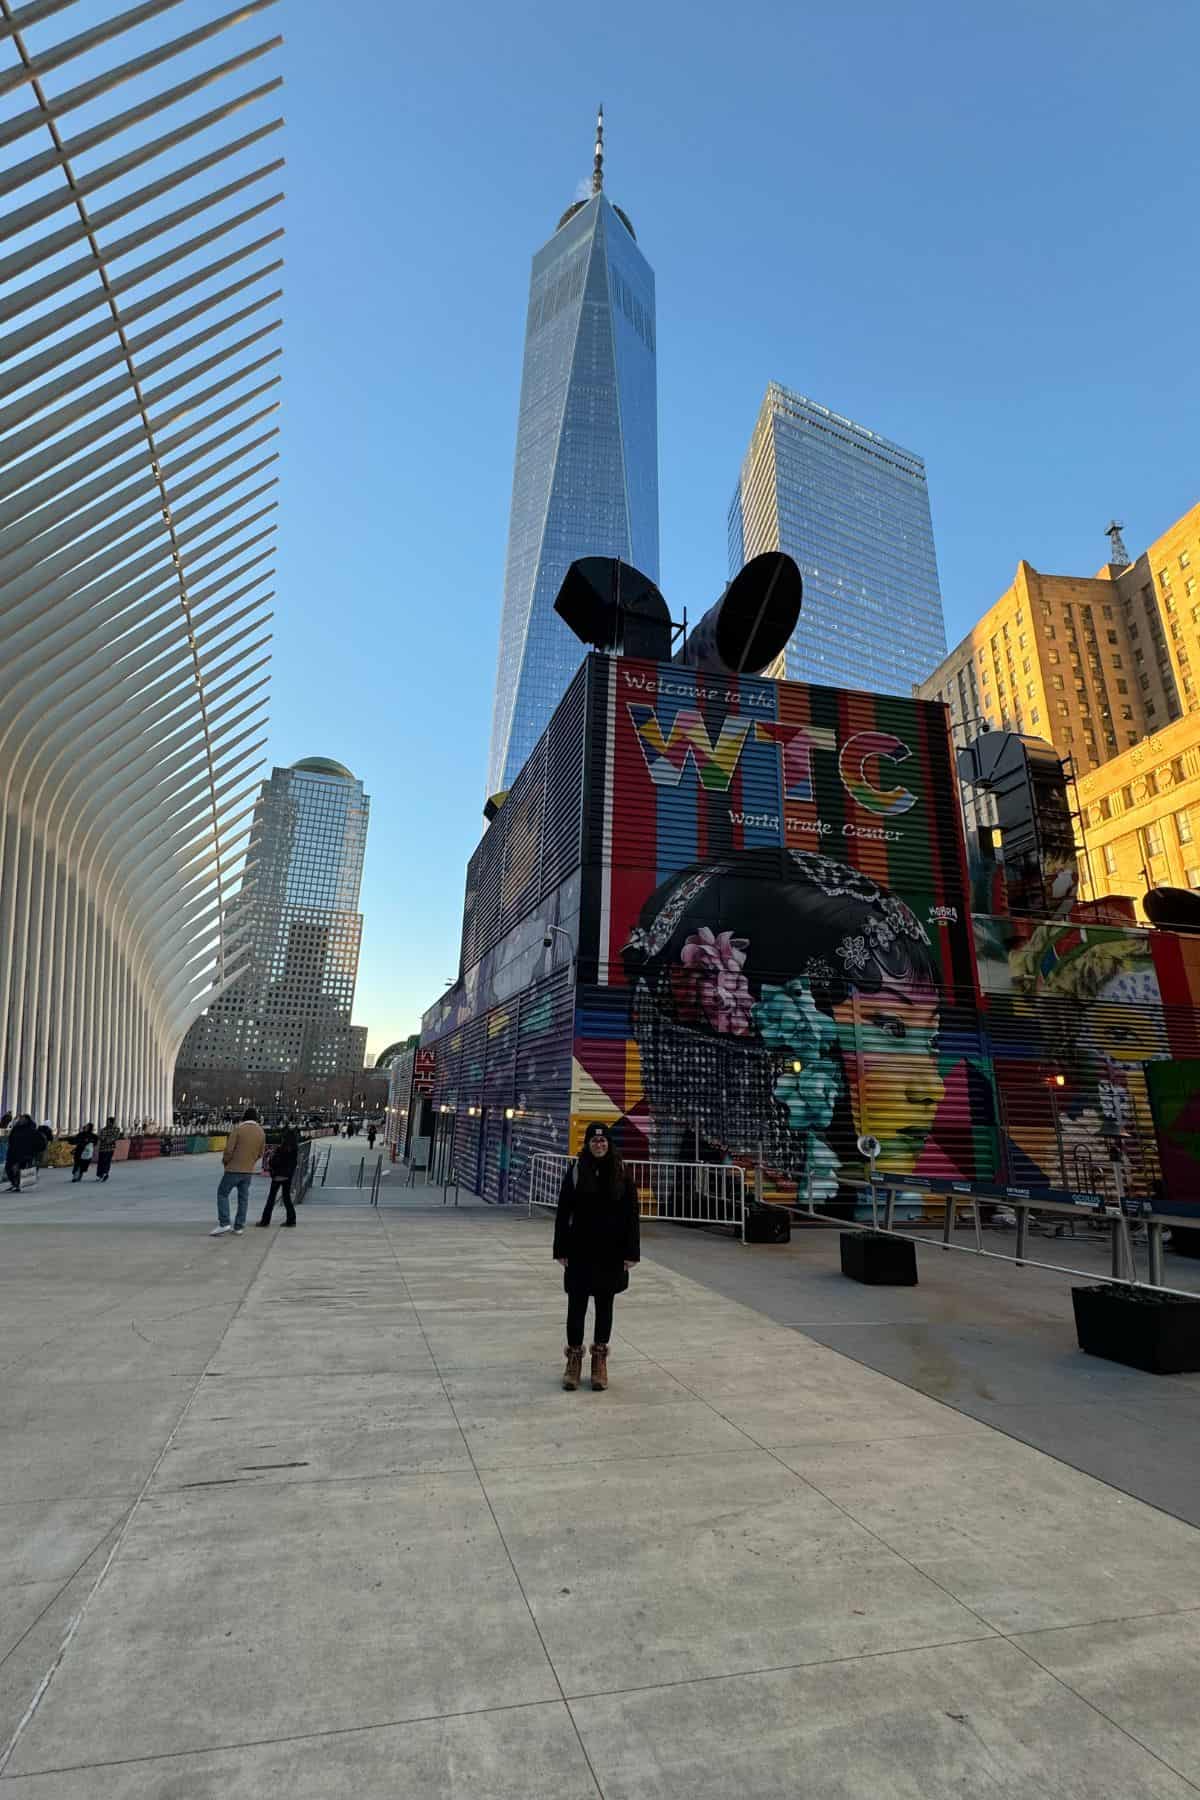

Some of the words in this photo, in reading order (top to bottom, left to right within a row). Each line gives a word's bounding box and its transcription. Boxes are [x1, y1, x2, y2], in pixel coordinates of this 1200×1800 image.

[621, 671, 719, 700] Welcome
[724, 690, 740, 703] to
[748, 690, 777, 708] the
[625, 701, 919, 816] WTC
[728, 810, 779, 830] World
[785, 817, 833, 838] Trade
[841, 823, 905, 841] Center
